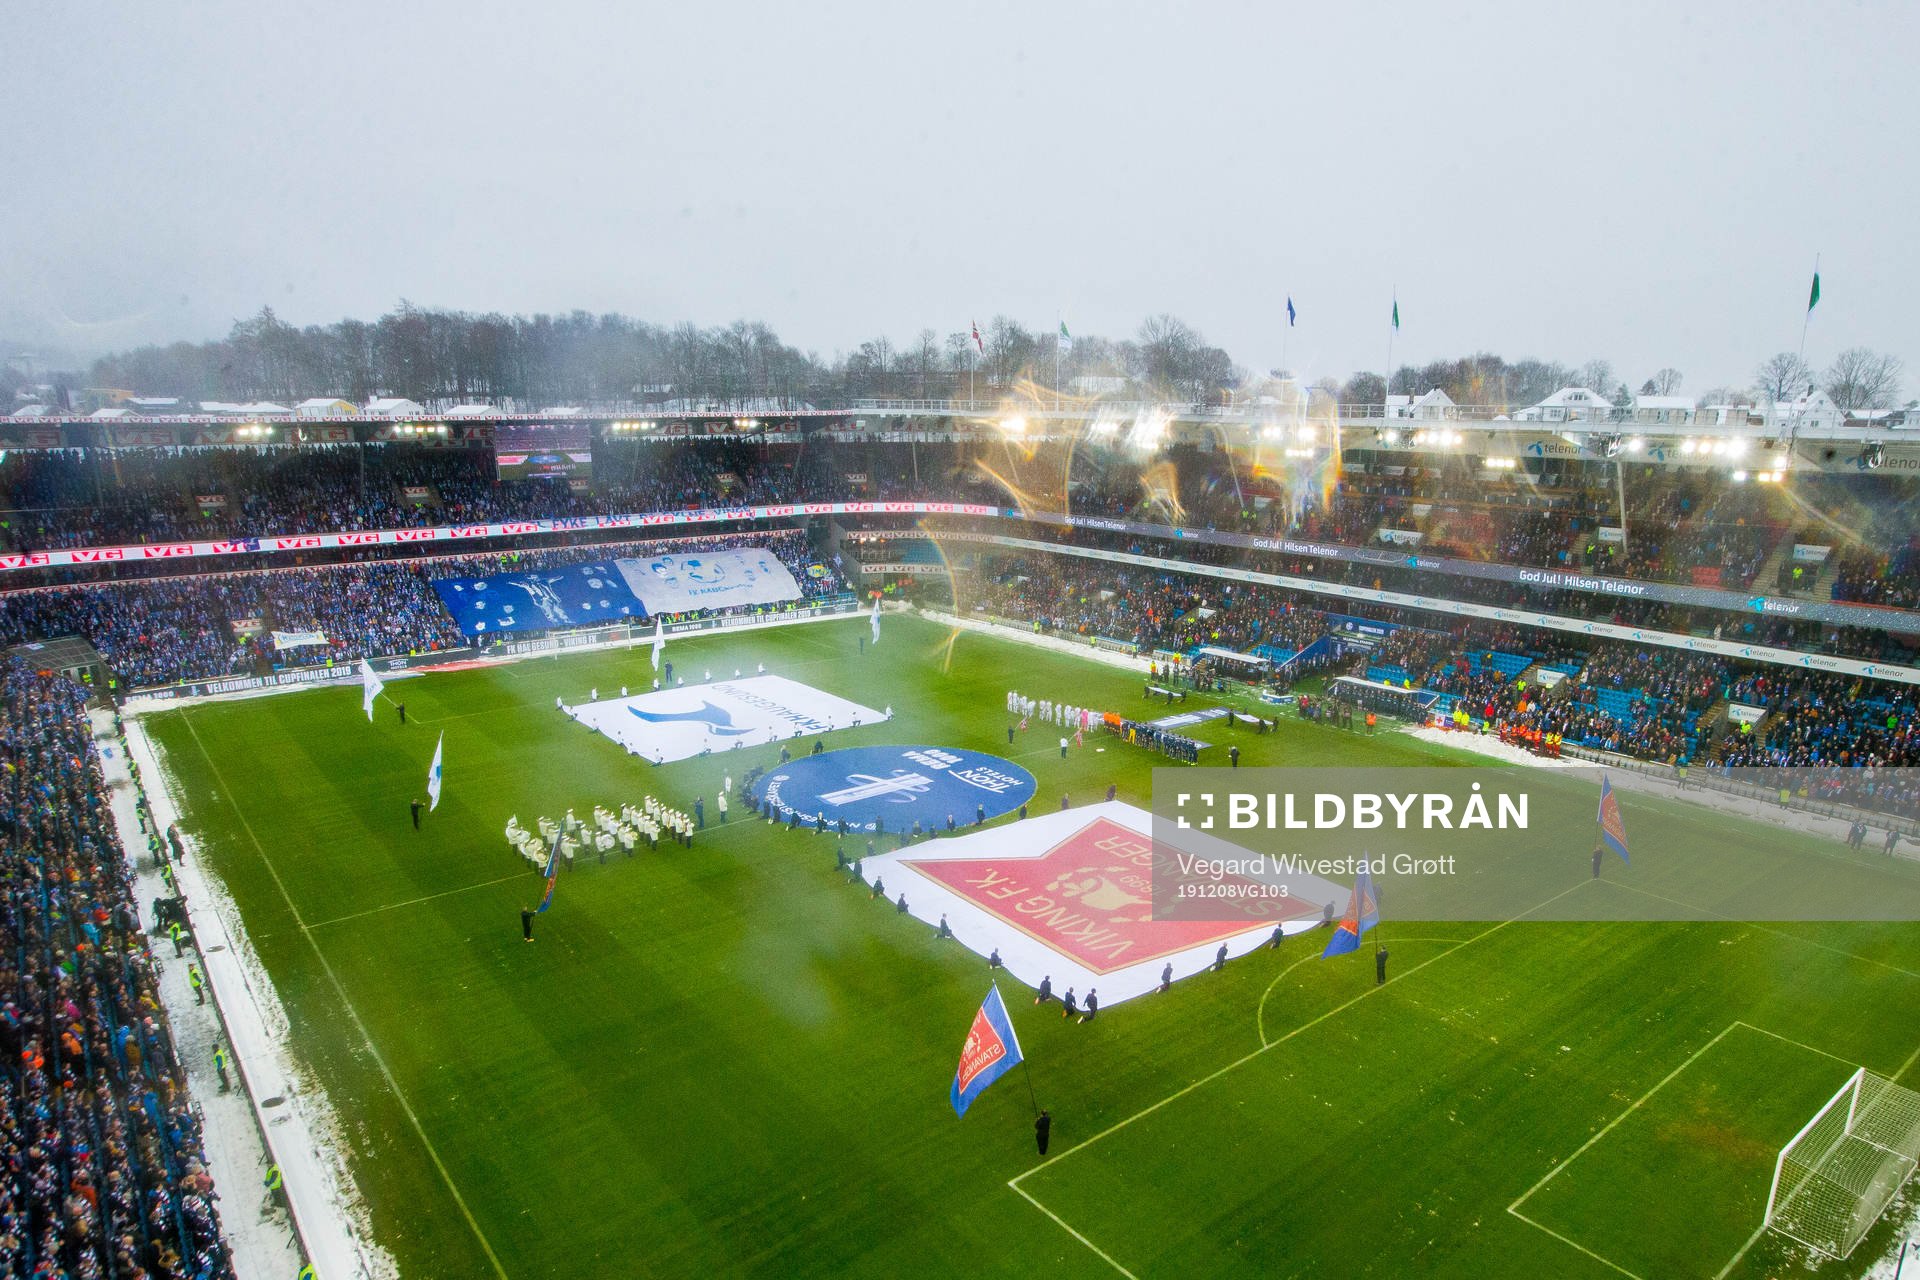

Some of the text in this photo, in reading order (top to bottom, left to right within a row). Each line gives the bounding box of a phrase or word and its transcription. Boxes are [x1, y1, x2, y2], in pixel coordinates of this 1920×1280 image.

[1544, 444, 1581, 454] telenor
[766, 506, 793, 516] VG
[803, 504, 832, 513] VG
[844, 503, 874, 512] VG
[885, 503, 914, 512] VG
[926, 504, 954, 513] VG
[450, 527, 488, 538] VG
[503, 524, 538, 534] VG
[338, 534, 380, 545] VG
[396, 530, 435, 541] VG
[277, 538, 321, 549] VG
[1253, 539, 1338, 556] God Jul! Hilsen Telenor
[72, 549, 122, 562] VG
[144, 545, 193, 557] VG
[0, 554, 49, 568] VG
[1417, 560, 1440, 569] telenor
[1519, 571, 1644, 595] God Jul! Hilsen Telenor
[1764, 601, 1799, 613] telenor
[721, 617, 756, 627] VELKOMMEN
[764, 611, 798, 622] CUPFINALEN
[1641, 632, 1664, 640] telenor
[507, 644, 516, 654] FK
[588, 635, 597, 643] FK
[1694, 641, 1718, 649] telenor
[1750, 649, 1775, 657] telenor
[1810, 658, 1838, 667] telenor
[1874, 668, 1904, 677] telenor
[206, 666, 352, 693] VELKOMMEN TIL CUPFINALEN 2019
[901, 750, 952, 770] REMA
[922, 749, 964, 764] 1000
[957, 769, 1013, 791] THON
[975, 766, 1024, 786] HOTELS
[965, 867, 1134, 960] VIKING F.K.
